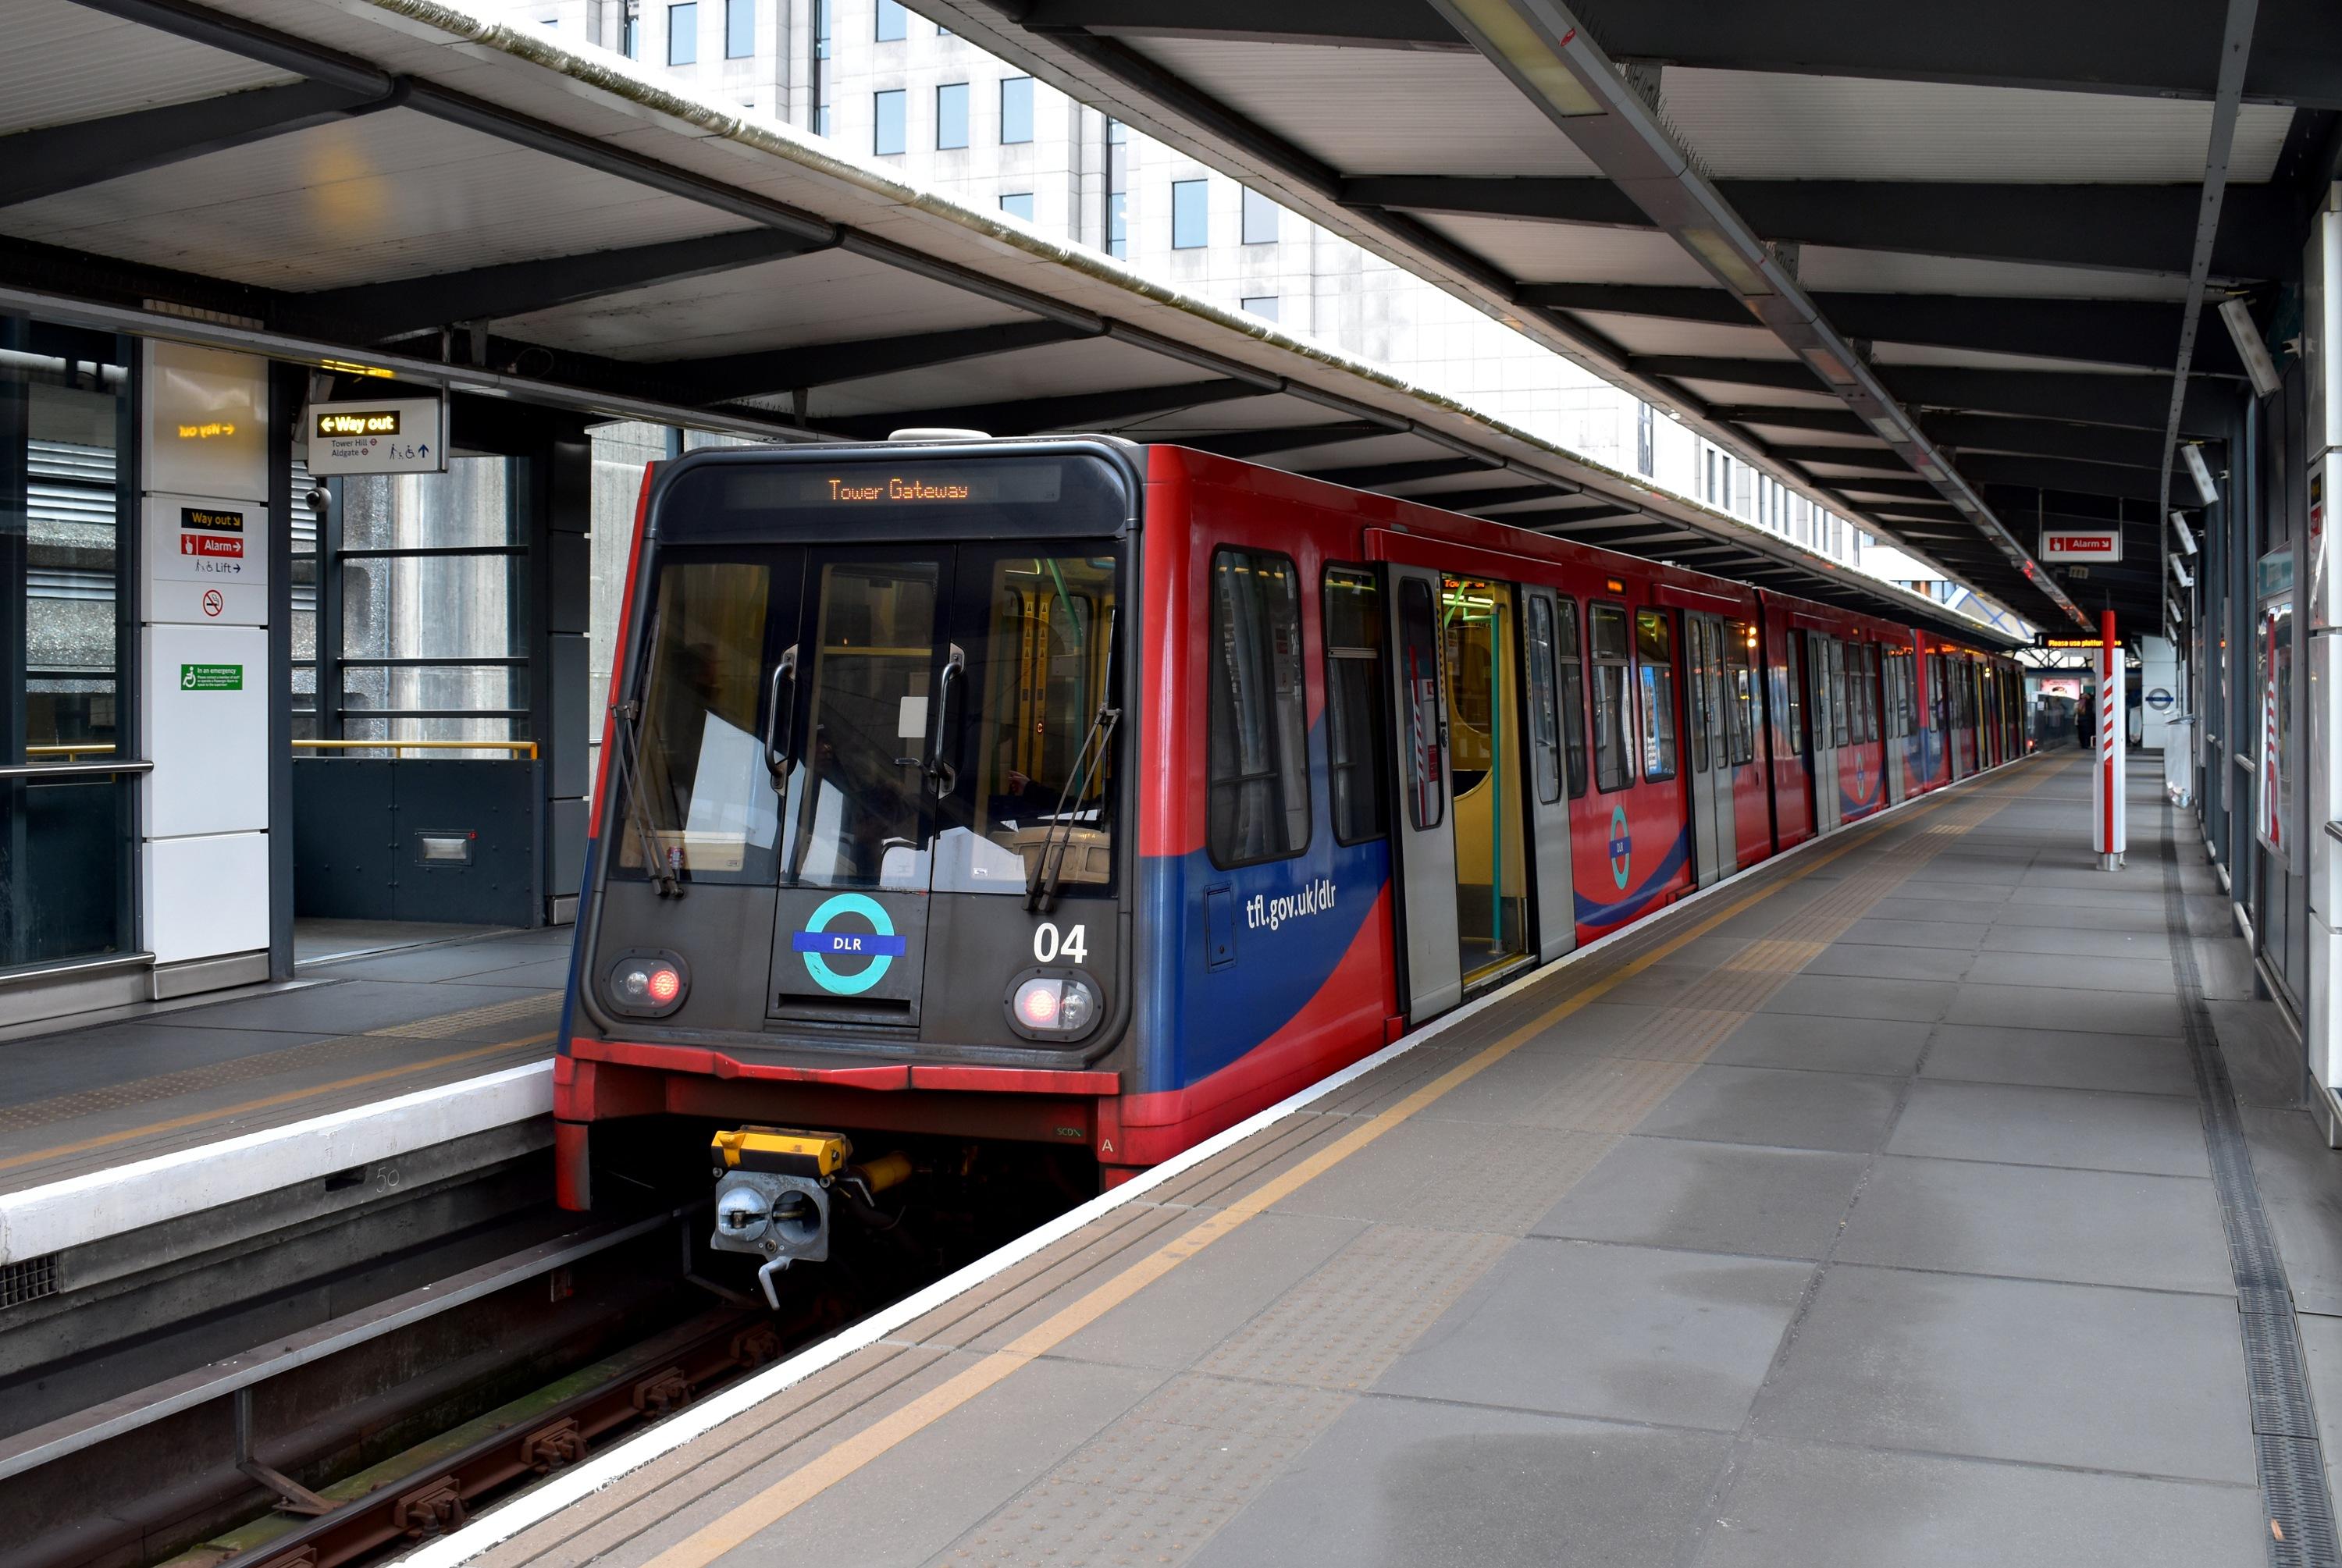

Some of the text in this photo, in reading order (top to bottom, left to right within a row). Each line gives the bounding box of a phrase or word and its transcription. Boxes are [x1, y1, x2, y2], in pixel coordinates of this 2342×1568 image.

[334, 415, 394, 434] Way out
[332, 449, 359, 458] Aldgate
[829, 478, 968, 500] Tower Gateway
[192, 512, 232, 526] Way out
[204, 539, 233, 552] Alarm
[2073, 539, 2100, 548] Alarm
[215, 562, 232, 574] Lift
[1247, 879, 1336, 930] tfl.gov.uk/dlr
[833, 937, 862, 951] DLR
[1034, 922, 1088, 964] 04
[1102, 1139, 1114, 1153] A
[376, 1166, 400, 1193] 50
